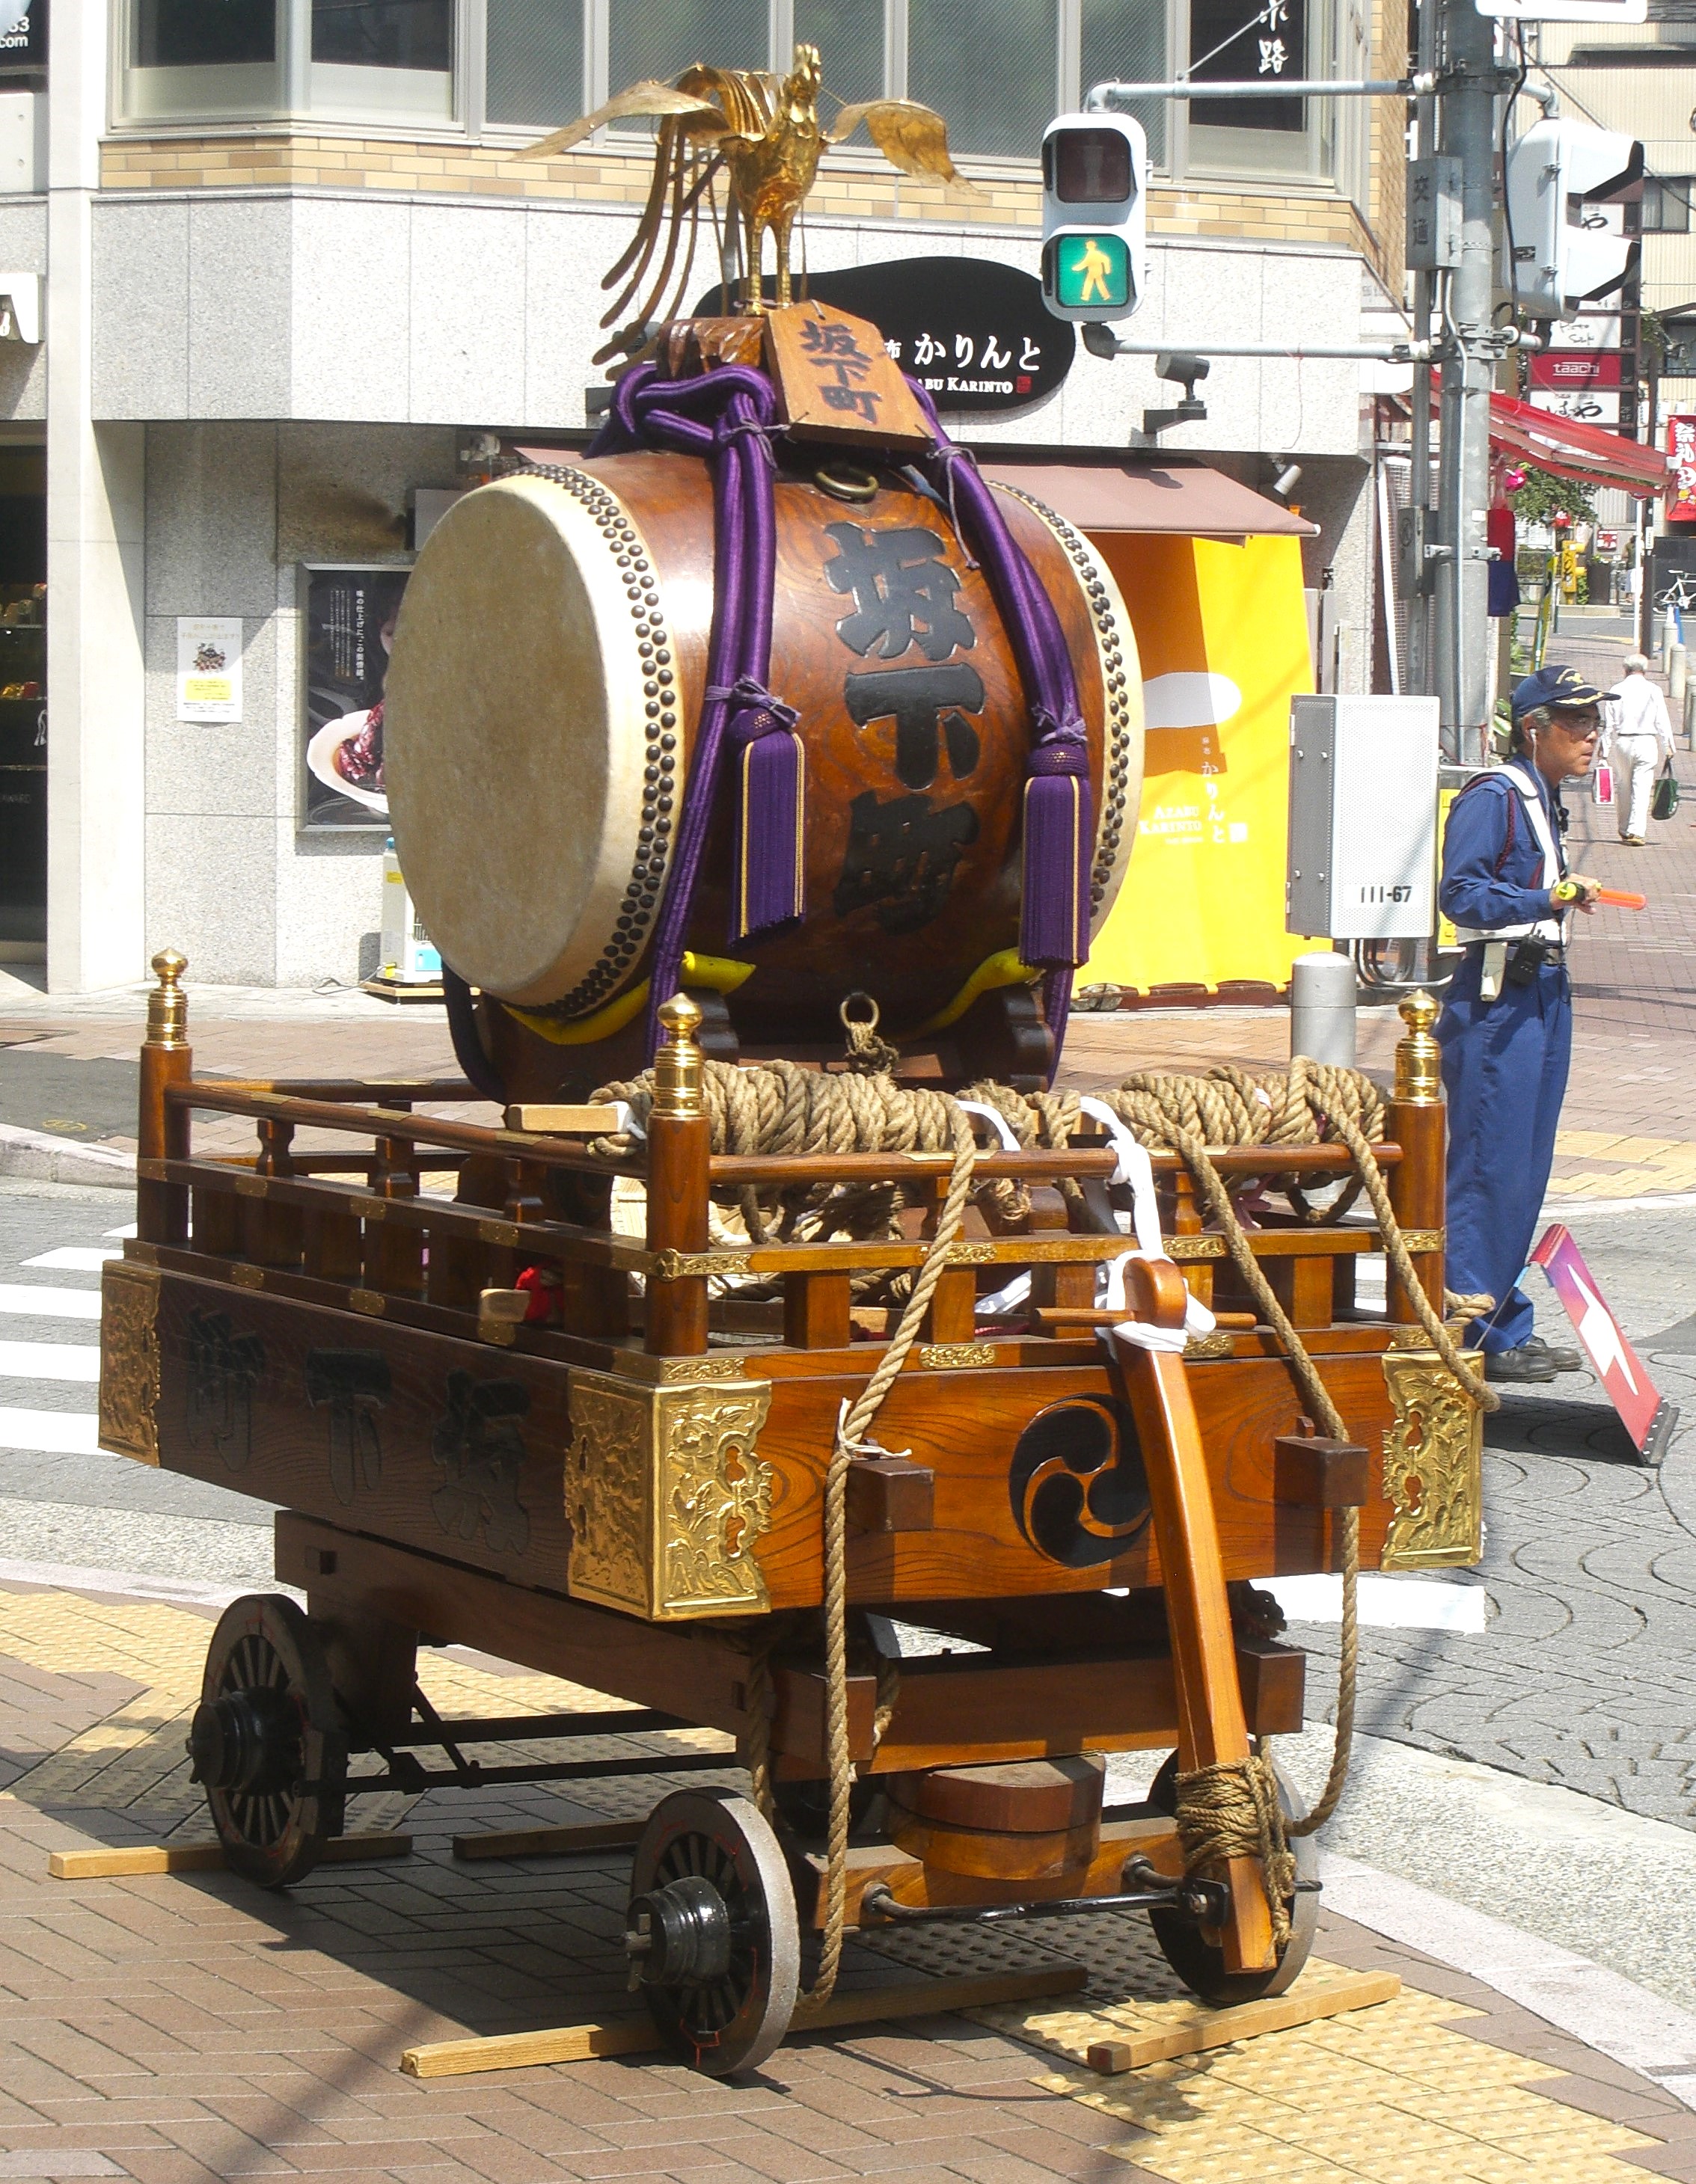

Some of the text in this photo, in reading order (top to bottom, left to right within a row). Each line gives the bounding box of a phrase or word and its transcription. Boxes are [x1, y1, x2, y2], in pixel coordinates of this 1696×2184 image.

[914, 333, 1041, 371] かりんと
[798, 319, 882, 424] 坂下町
[1552, 362, 1599, 373] taachi
[917, 377, 944, 390] BU
[947, 377, 1014, 394] KARINTO
[1361, 886, 1412, 903] 111-67
